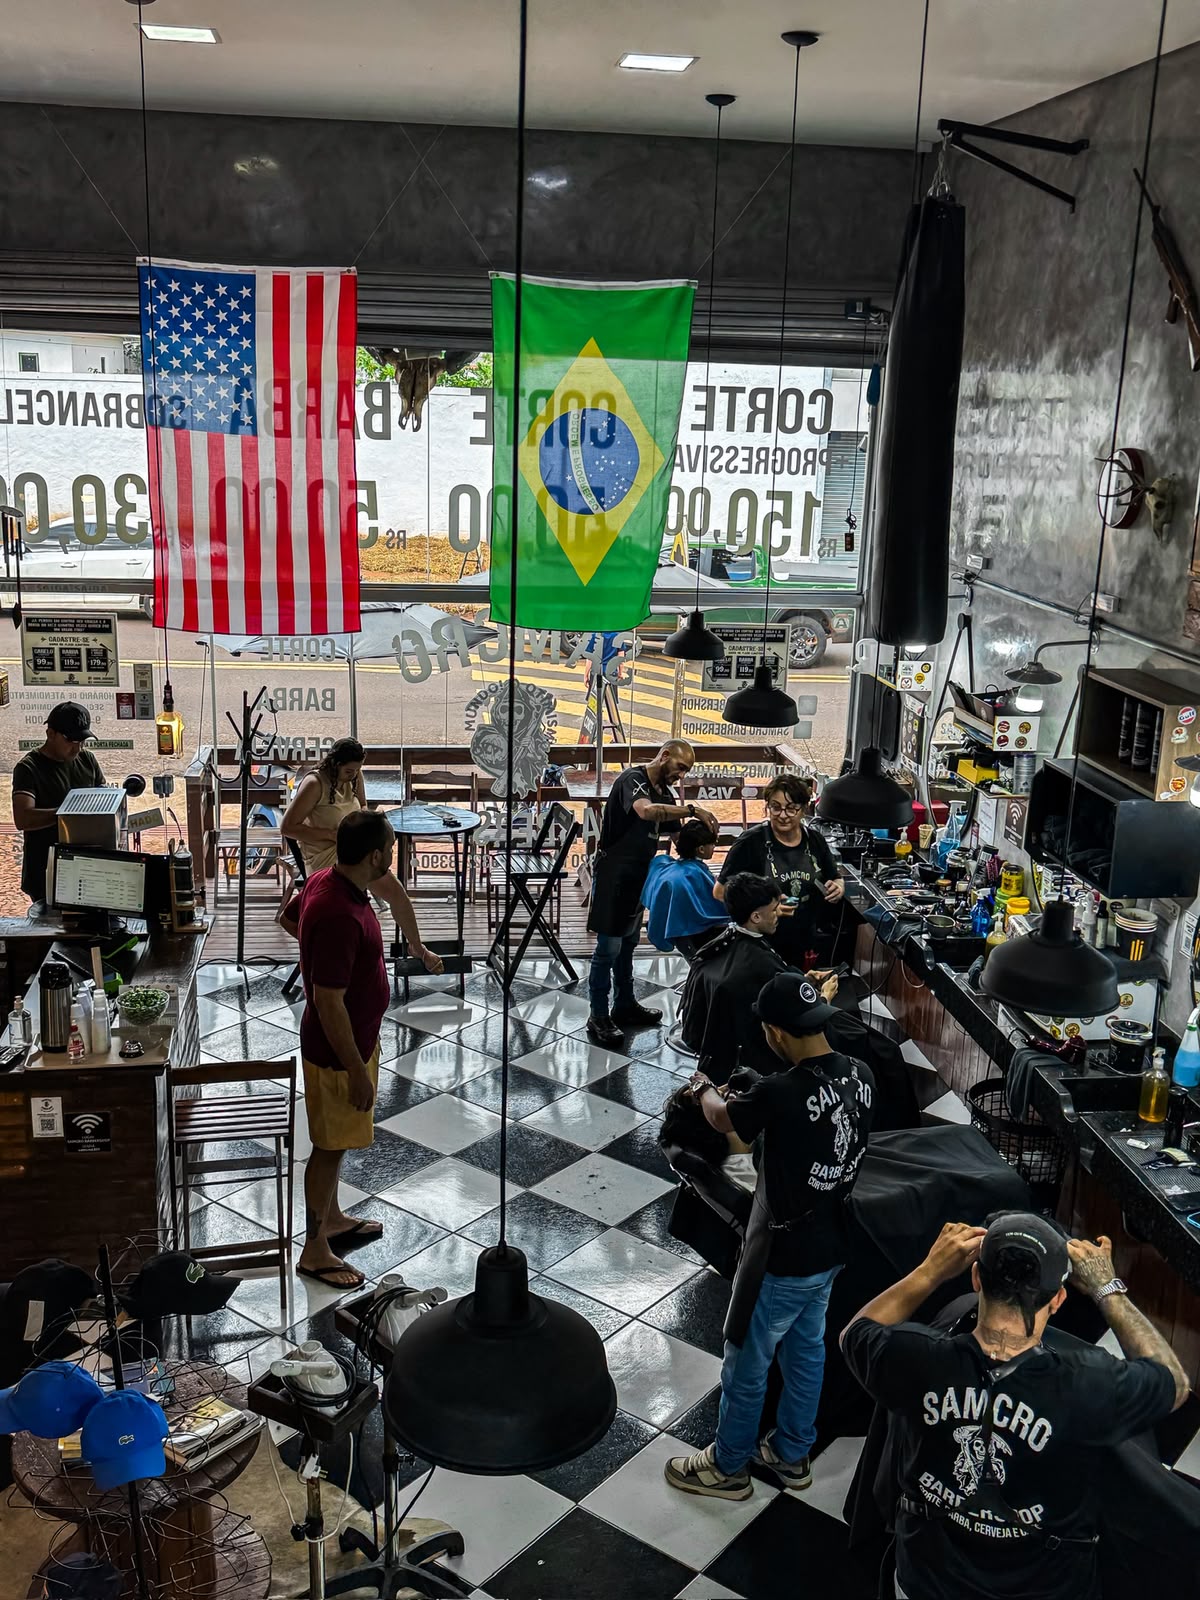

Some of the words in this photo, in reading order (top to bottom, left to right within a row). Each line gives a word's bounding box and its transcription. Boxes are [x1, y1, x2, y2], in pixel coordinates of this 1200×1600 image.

[1179, 709, 1196, 722] Gulf
[806, 1075, 872, 1122] SAMRO
[922, 1387, 1052, 1453] SAMCRO
[974, 1521, 1012, 1538] CERVEJA
